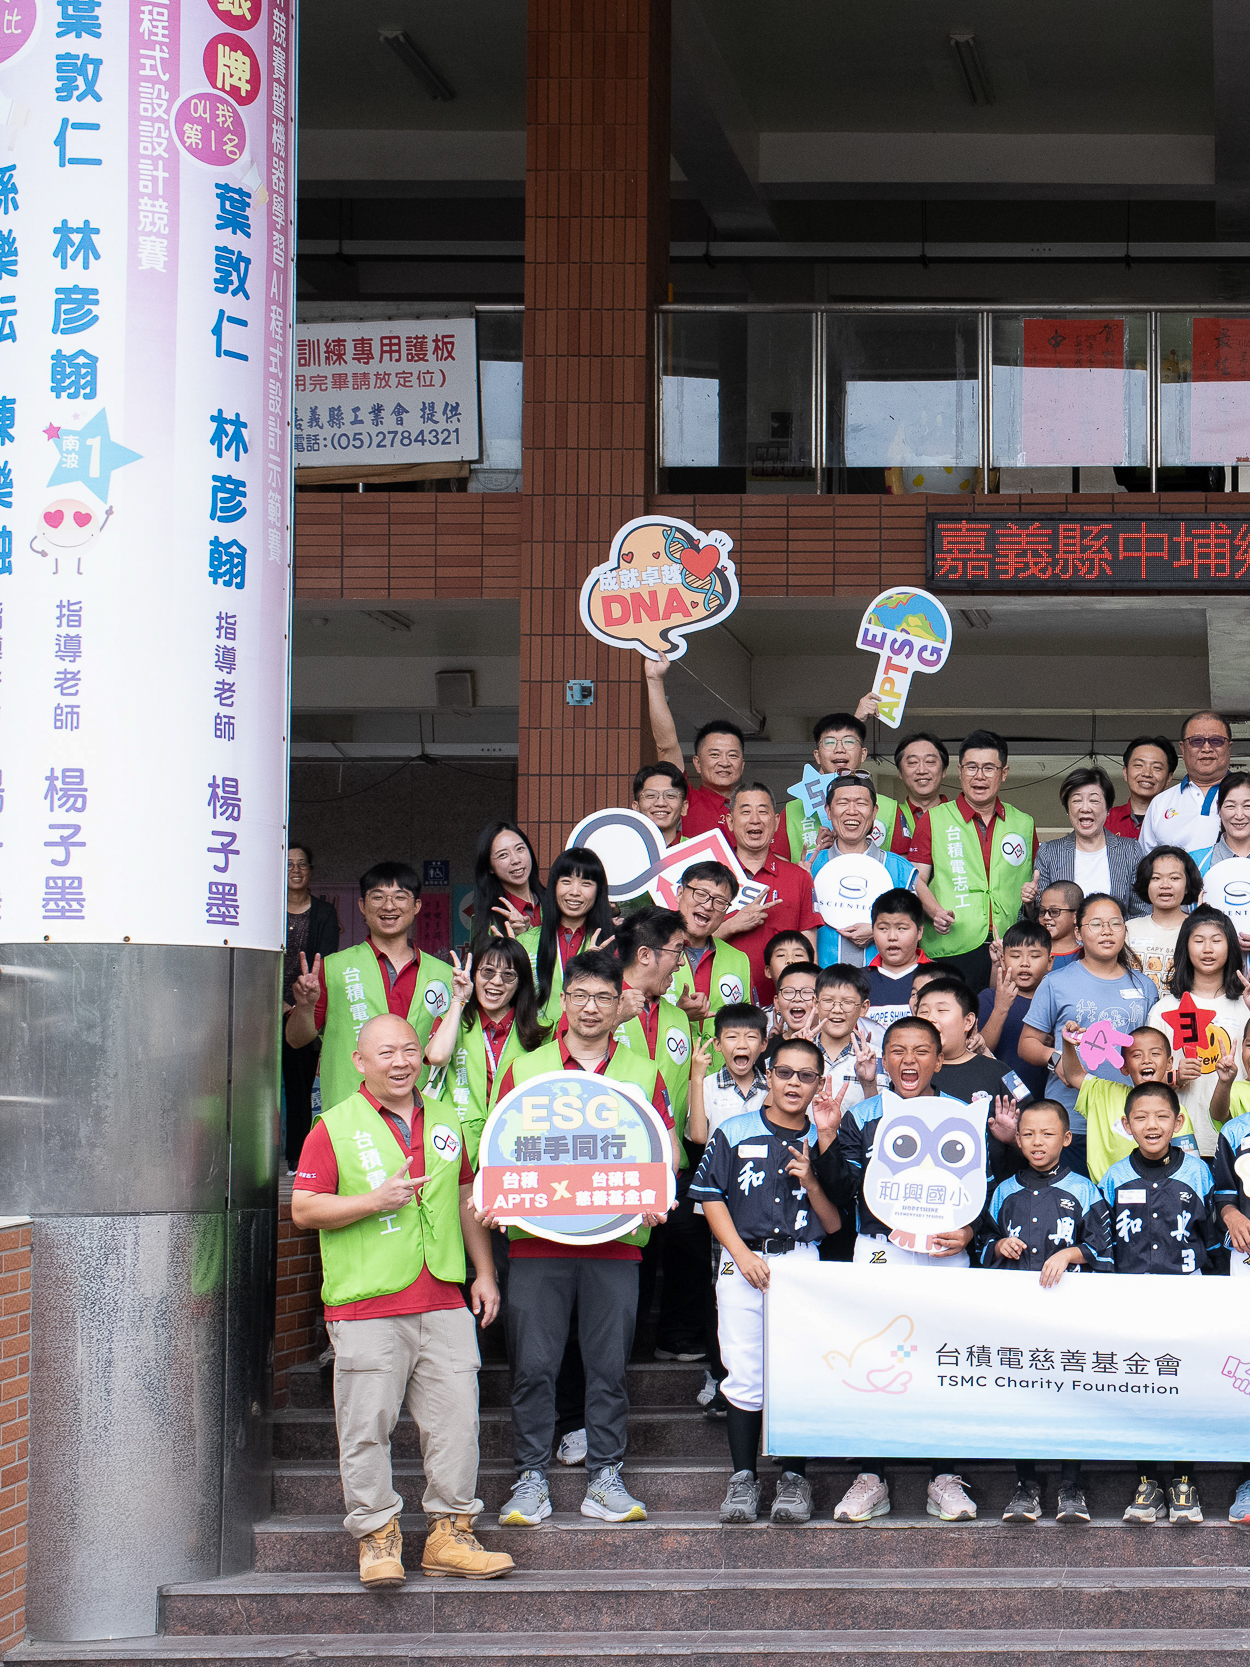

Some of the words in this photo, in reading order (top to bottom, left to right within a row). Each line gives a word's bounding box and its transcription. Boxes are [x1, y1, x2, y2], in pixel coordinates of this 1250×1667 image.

[53, 0, 103, 169] 葉敦仁
[190, 98, 234, 130] 叫我
[137, 0, 170, 273] 程式設設計競賽
[210, 182, 252, 363] 葉敦仁
[266, 0, 288, 566] 競賽暨機器學習AI程式設計示範賽
[296, 334, 456, 367] 訓練專用護板
[419, 401, 462, 425] 提供
[598, 563, 682, 592] 成就卓越
[601, 587, 693, 628] DNA
[53, 599, 83, 732] 指導老師
[214, 611, 238, 742] 指導老師
[42, 767, 88, 920] 楊子墨
[206, 775, 242, 927] 楊子墨
[945, 825, 971, 909] 台積電志工
[819, 899, 873, 911] SCIENTEC
[521, 1094, 620, 1131] ESG
[514, 1134, 627, 1162] 攜手同行
[502, 1171, 539, 1189] 台積
[591, 1171, 641, 1188] 台積電
[738, 1160, 766, 1196] 和
[879, 1181, 970, 1207] 和興國小
[492, 1193, 549, 1210] APTS
[575, 1189, 657, 1207] 慈善基金會
[1115, 1208, 1144, 1243] 和
[1181, 1248, 1196, 1273] 3
[936, 1342, 1182, 1377] 台積電慈善基金會
[937, 1375, 987, 1387] TSMC
[994, 1376, 1065, 1392] Charity
[1072, 1380, 1179, 1395] Foundation
